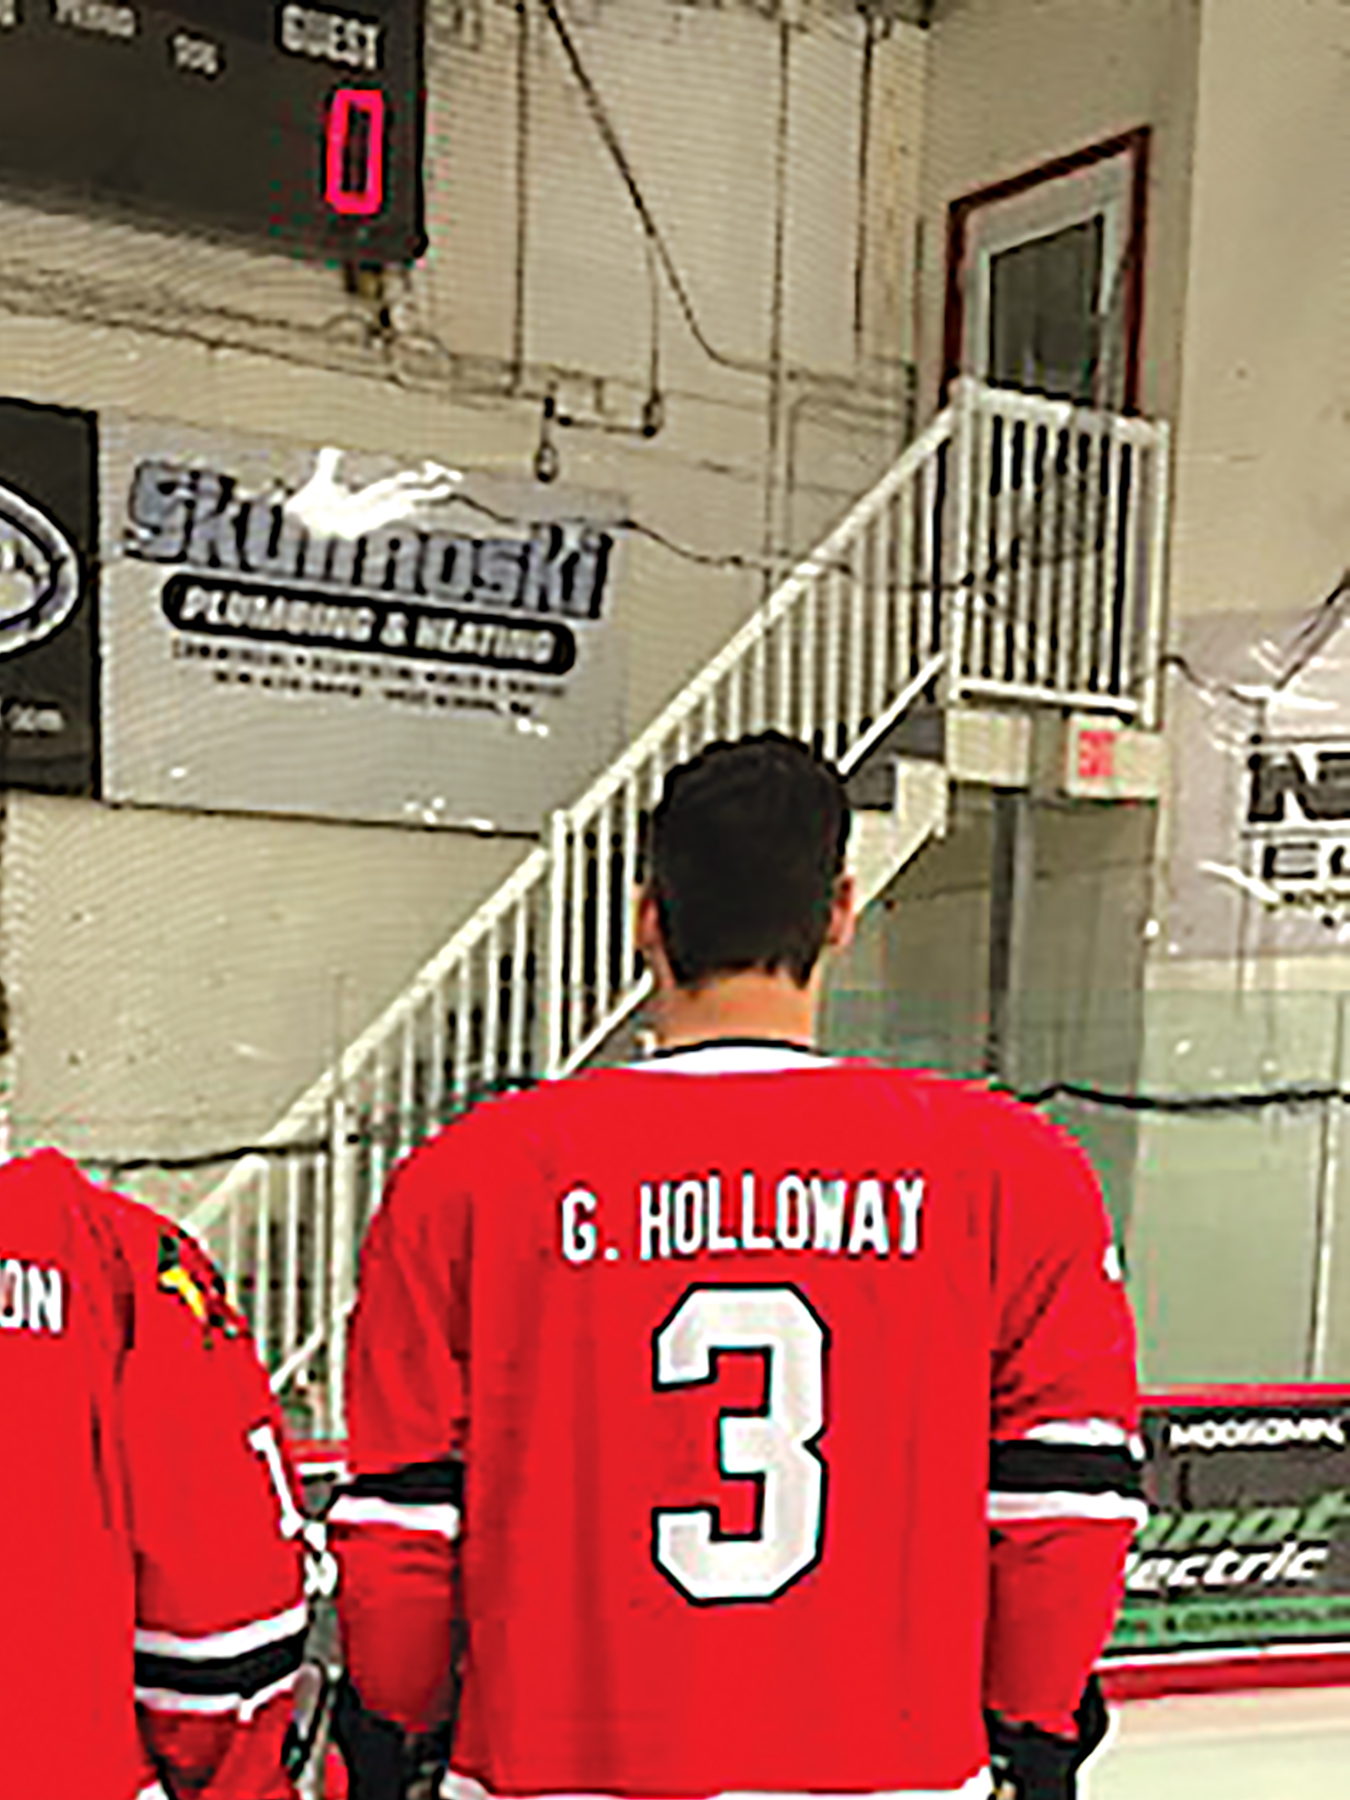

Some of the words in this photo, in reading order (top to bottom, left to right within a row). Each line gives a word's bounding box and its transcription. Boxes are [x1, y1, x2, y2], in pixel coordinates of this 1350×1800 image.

[280, 4, 378, 69] GUEST
[326, 88, 385, 214] 0
[180, 586, 376, 640] PLUMBING
[379, 610, 409, 648] &
[414, 615, 556, 664] HEATING
[560, 1184, 620, 1264] G.
[638, 1170, 926, 1262] HOLLOWAY
[652, 1282, 832, 1608] 3
